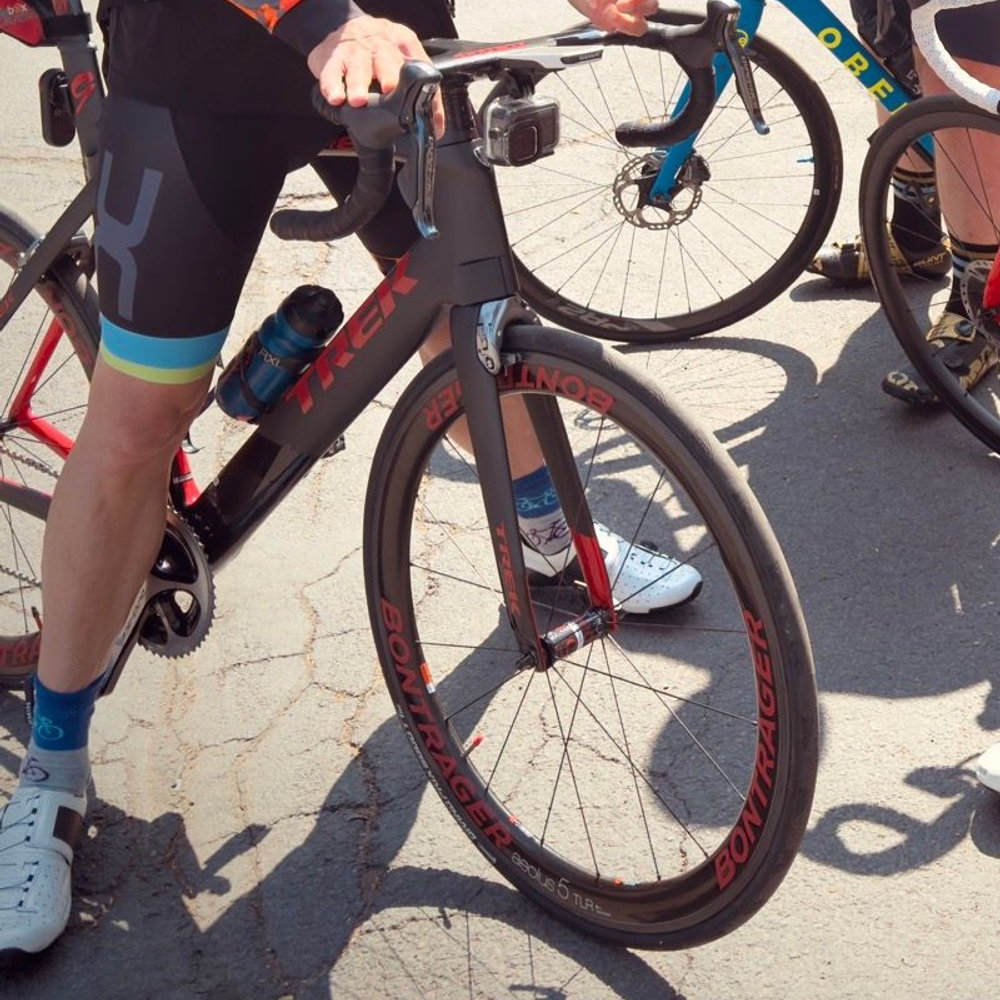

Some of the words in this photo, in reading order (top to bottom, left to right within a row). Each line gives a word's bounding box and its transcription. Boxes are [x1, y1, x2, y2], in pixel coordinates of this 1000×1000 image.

[817, 27, 908, 115] OBE
[284, 252, 419, 415] TREK
[381, 599, 513, 848] BONTRAGER
[714, 610, 777, 890] BONTRAGER
[511, 852, 555, 893] aeolus
[557, 878, 571, 900] 5
[573, 893, 594, 911] TLR
